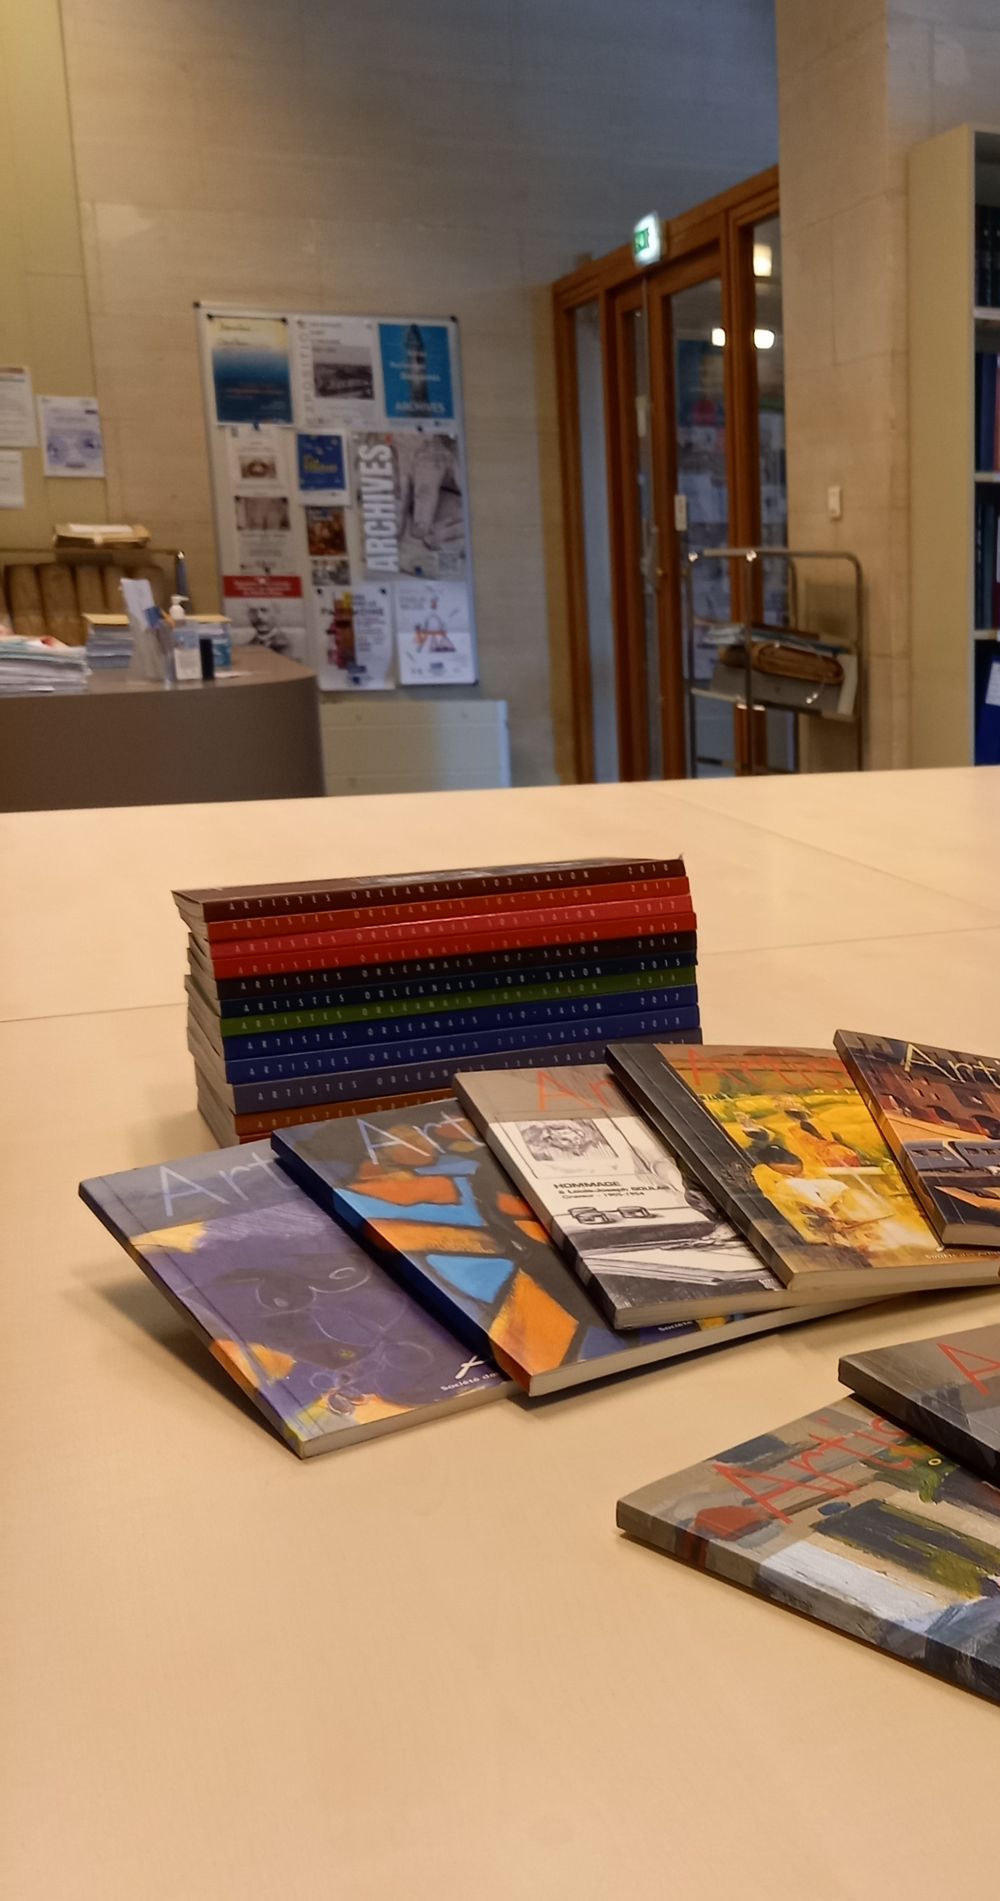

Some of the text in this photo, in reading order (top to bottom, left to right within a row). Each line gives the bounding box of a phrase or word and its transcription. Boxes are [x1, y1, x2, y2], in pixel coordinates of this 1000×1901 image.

[359, 444, 399, 573] ARCHIVES
[230, 893, 331, 910] ARTISTES
[533, 871, 589, 883] SALON
[241, 973, 341, 990] ARTISTES
[544, 946, 598, 958] SALON
[244, 994, 344, 1012] ARTISTES
[546, 967, 601, 980] SALON
[641, 958, 680, 970] 2015
[242, 1011, 342, 1029] ARTISTES
[543, 983, 597, 995] SALON
[248, 1031, 347, 1049] ARTISTES
[547, 1002, 601, 1016] SALON
[641, 993, 679, 1005] 2017
[250, 1057, 349, 1075] ARTISTES
[547, 1026, 602, 1040] SALON
[258, 1080, 357, 1100] ARTISTES
[258, 1108, 357, 1128] ARTISTES
[553, 1181, 621, 1190] HOMMAGE
